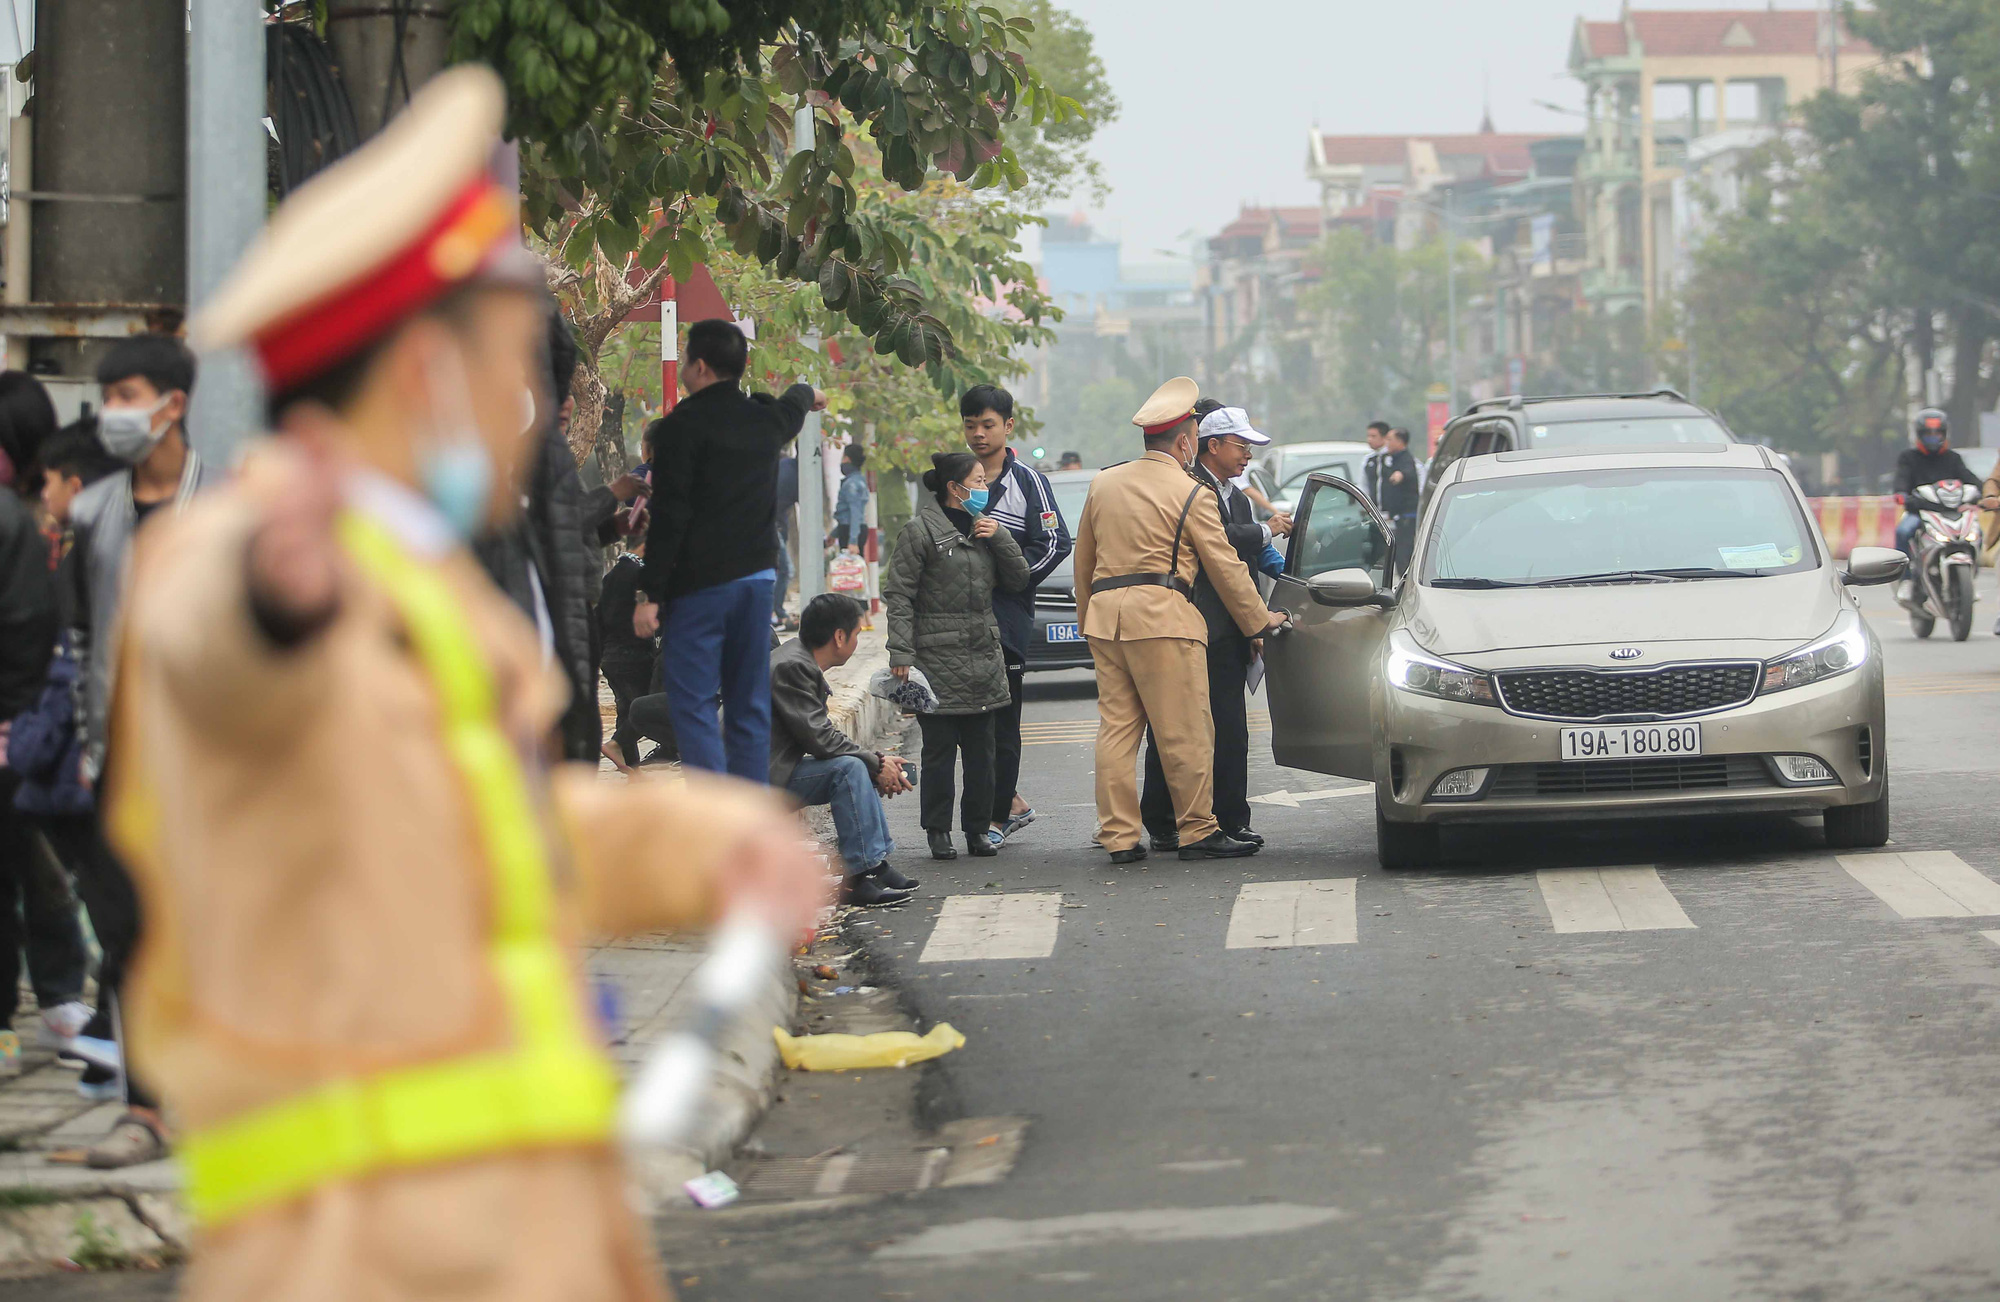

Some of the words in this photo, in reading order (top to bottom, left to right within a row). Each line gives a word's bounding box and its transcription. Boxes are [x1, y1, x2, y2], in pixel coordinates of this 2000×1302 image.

[1051, 625, 1085, 640] 19A-
[1614, 649, 1638, 657] KIA
[1568, 727, 1696, 756] 19A-180.80
